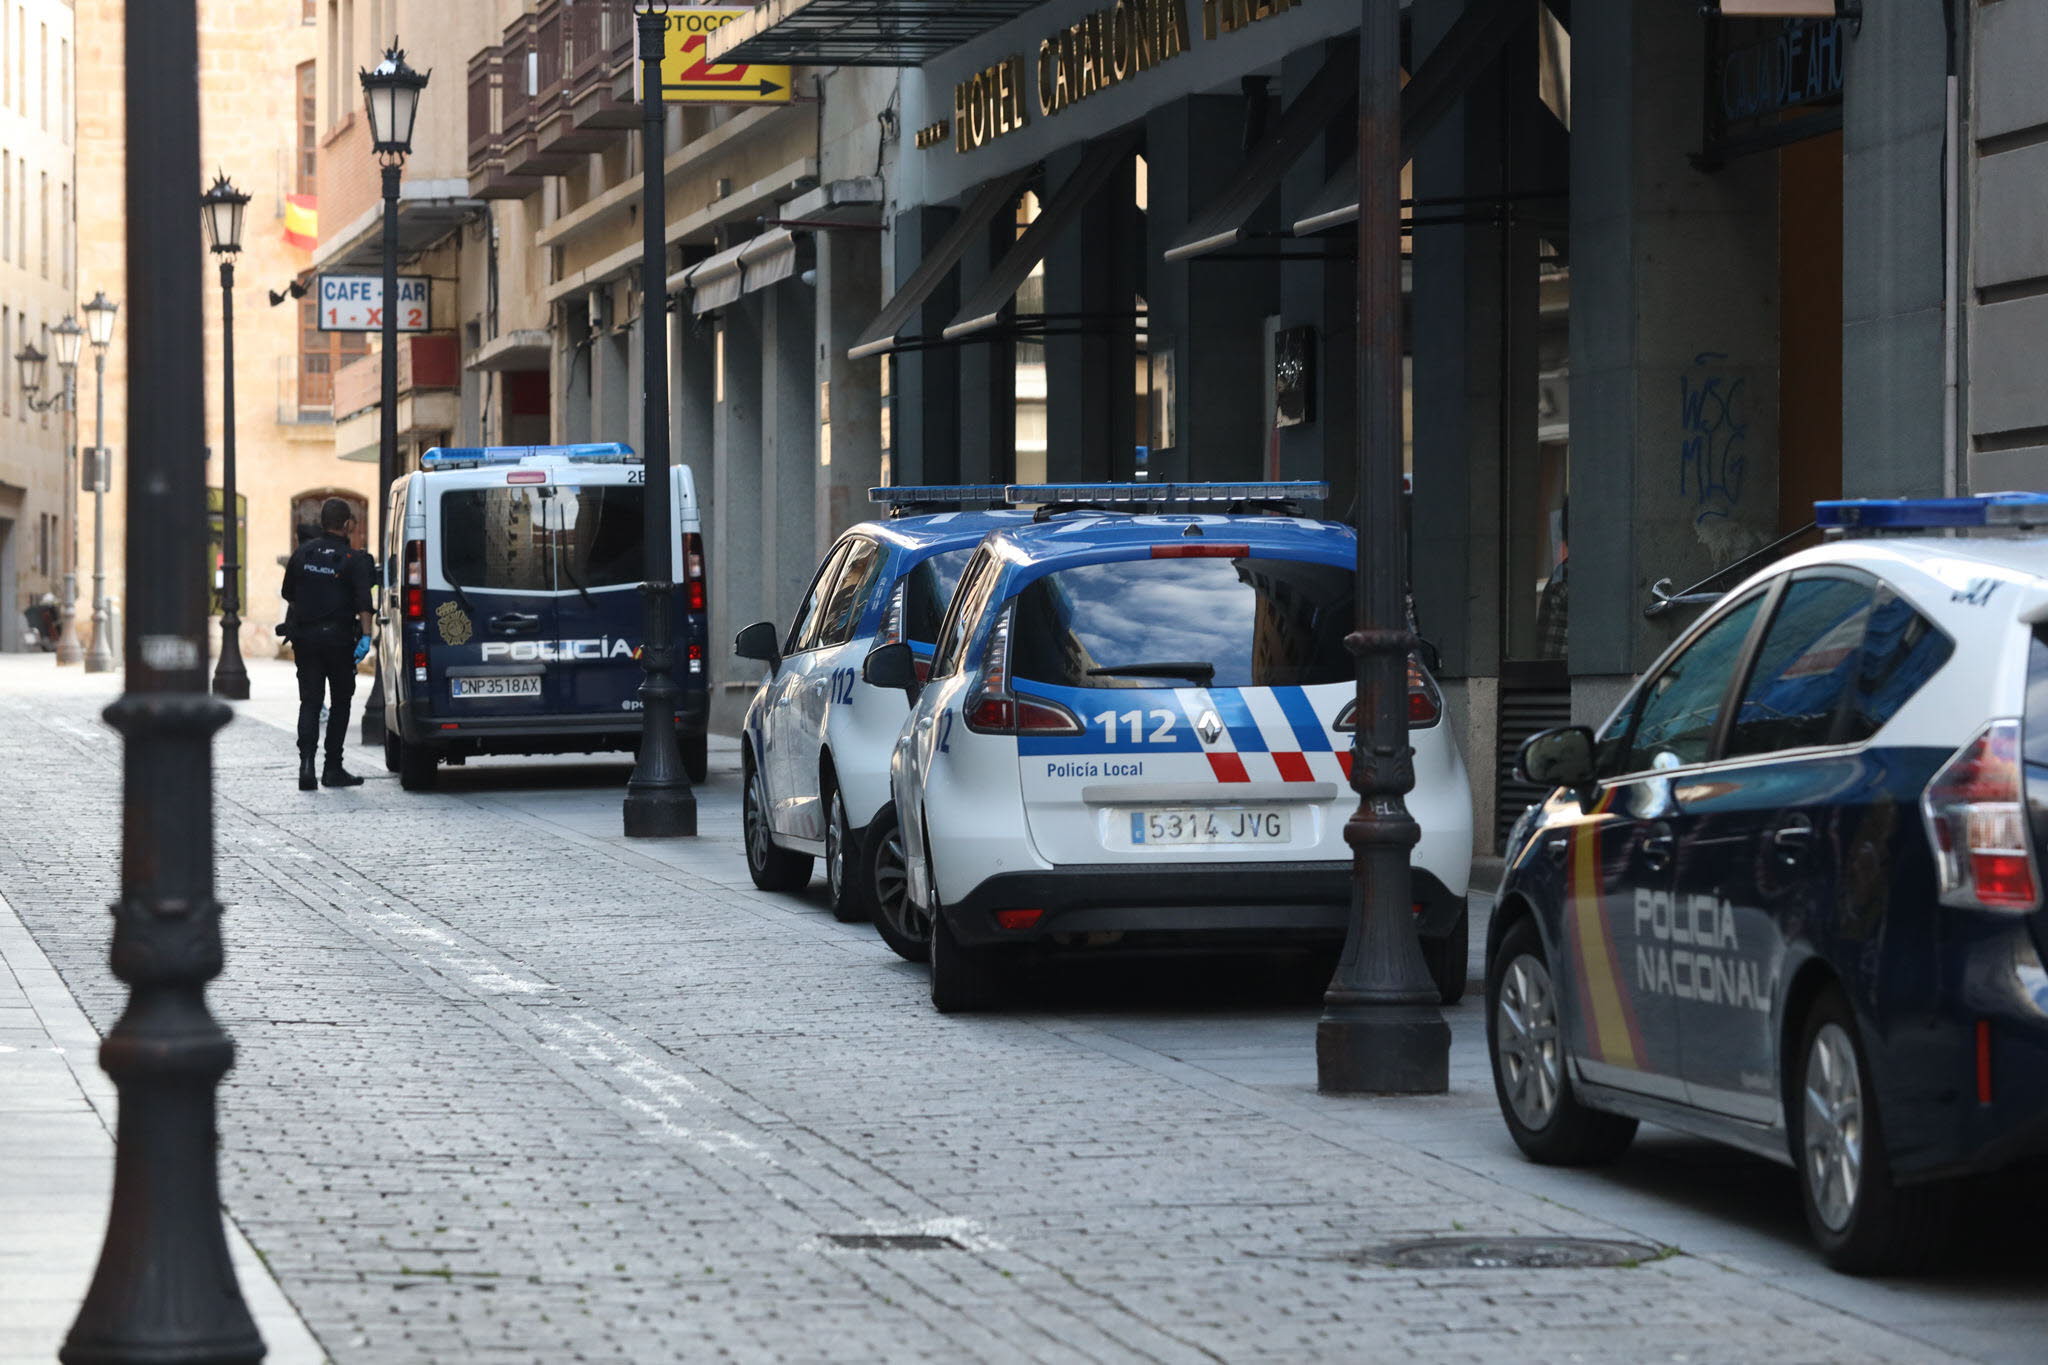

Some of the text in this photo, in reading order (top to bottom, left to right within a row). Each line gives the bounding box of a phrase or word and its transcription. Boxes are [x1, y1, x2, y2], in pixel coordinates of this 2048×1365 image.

[954, 0, 1190, 153] HOTEL CATALONIA
[324, 281, 371, 301] CAFE
[328, 308, 337, 325] 1
[408, 308, 422, 326] 2
[481, 634, 634, 662] POLICÍA
[831, 667, 855, 705] 112
[1094, 709, 1177, 744] 112
[1047, 761, 1143, 778] Policía Local
[1150, 813, 1218, 839] 5314
[1231, 813, 1281, 838] JVG
[1636, 944, 1771, 1012] NACIONAL
